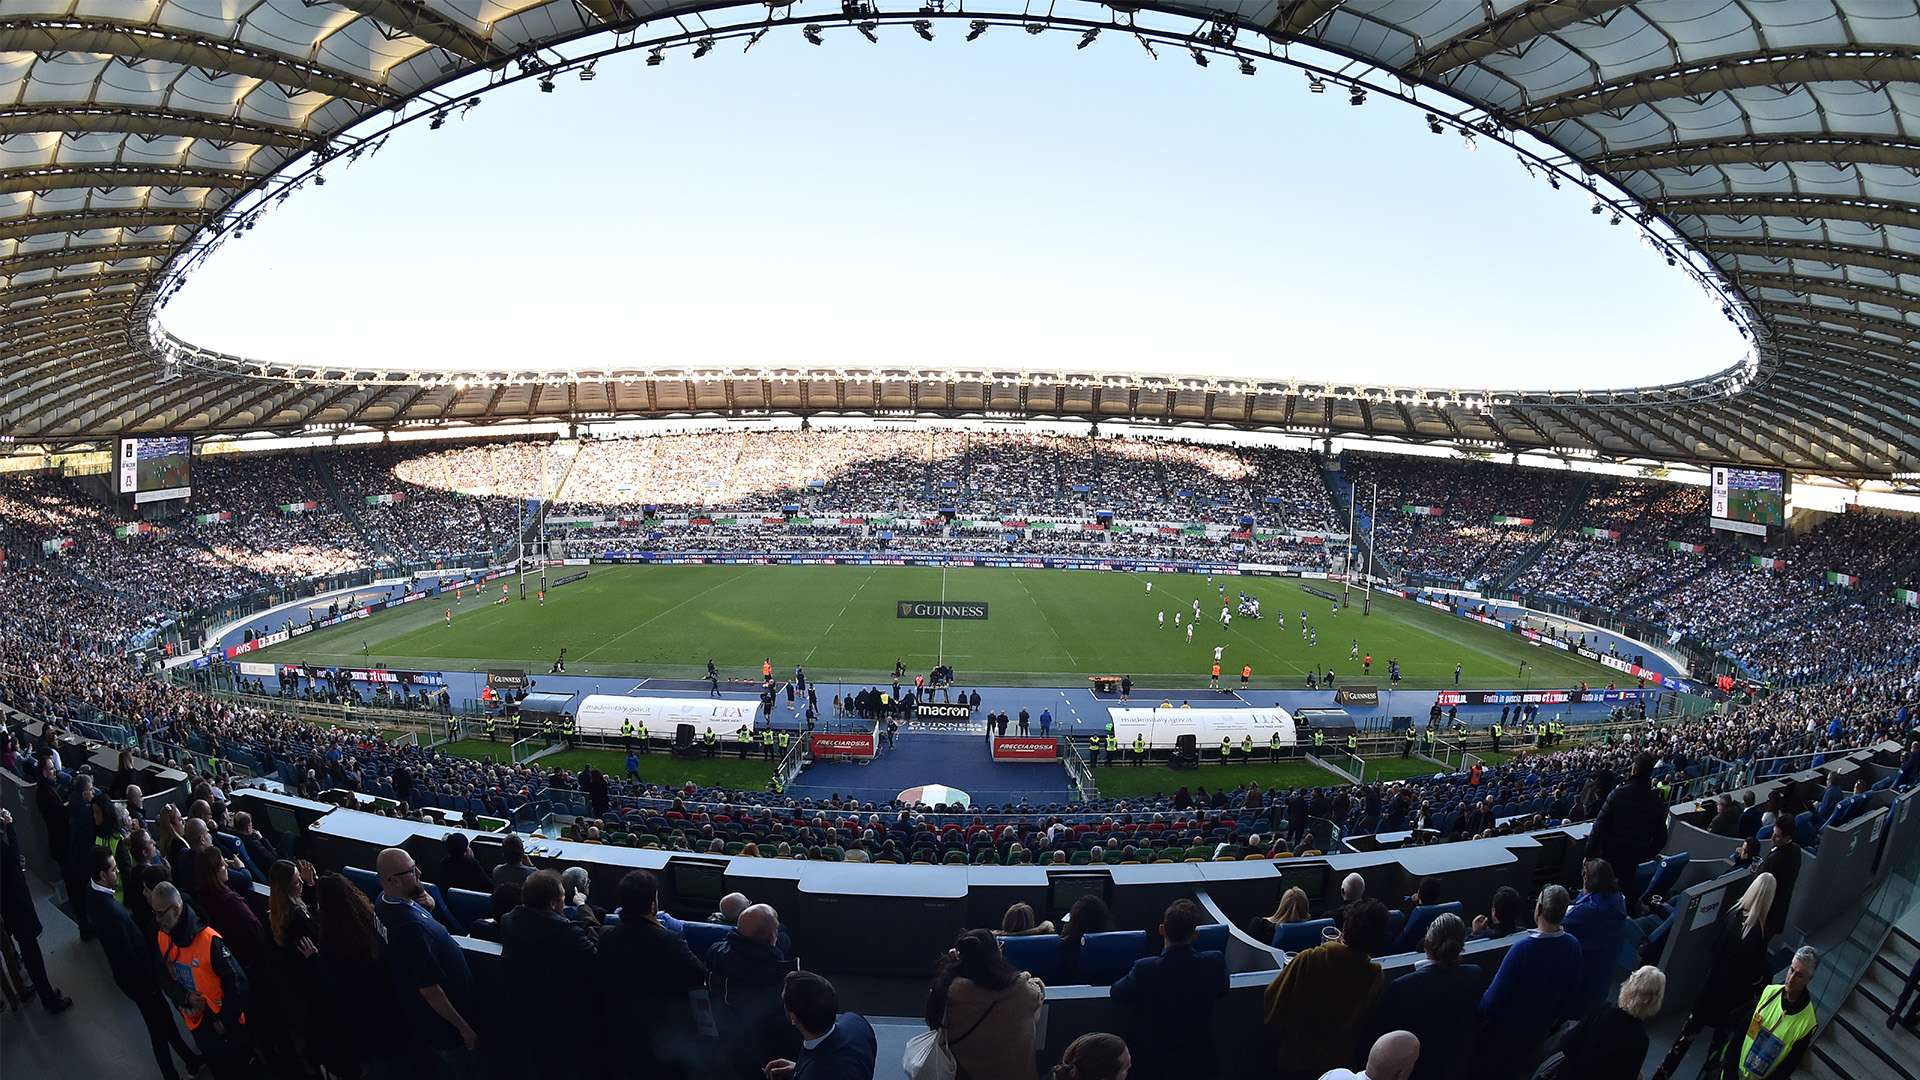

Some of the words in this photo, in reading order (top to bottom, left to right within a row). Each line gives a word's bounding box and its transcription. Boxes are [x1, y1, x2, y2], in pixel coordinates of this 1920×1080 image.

[914, 603, 984, 617] GUINNESS
[235, 642, 251, 655] AVIS
[1577, 647, 1599, 660] macron
[1637, 668, 1654, 680] AVIS
[1349, 692, 1377, 700] GUINNESS
[918, 705, 969, 717] macron
[816, 739, 870, 747] FRECCIAROSSA
